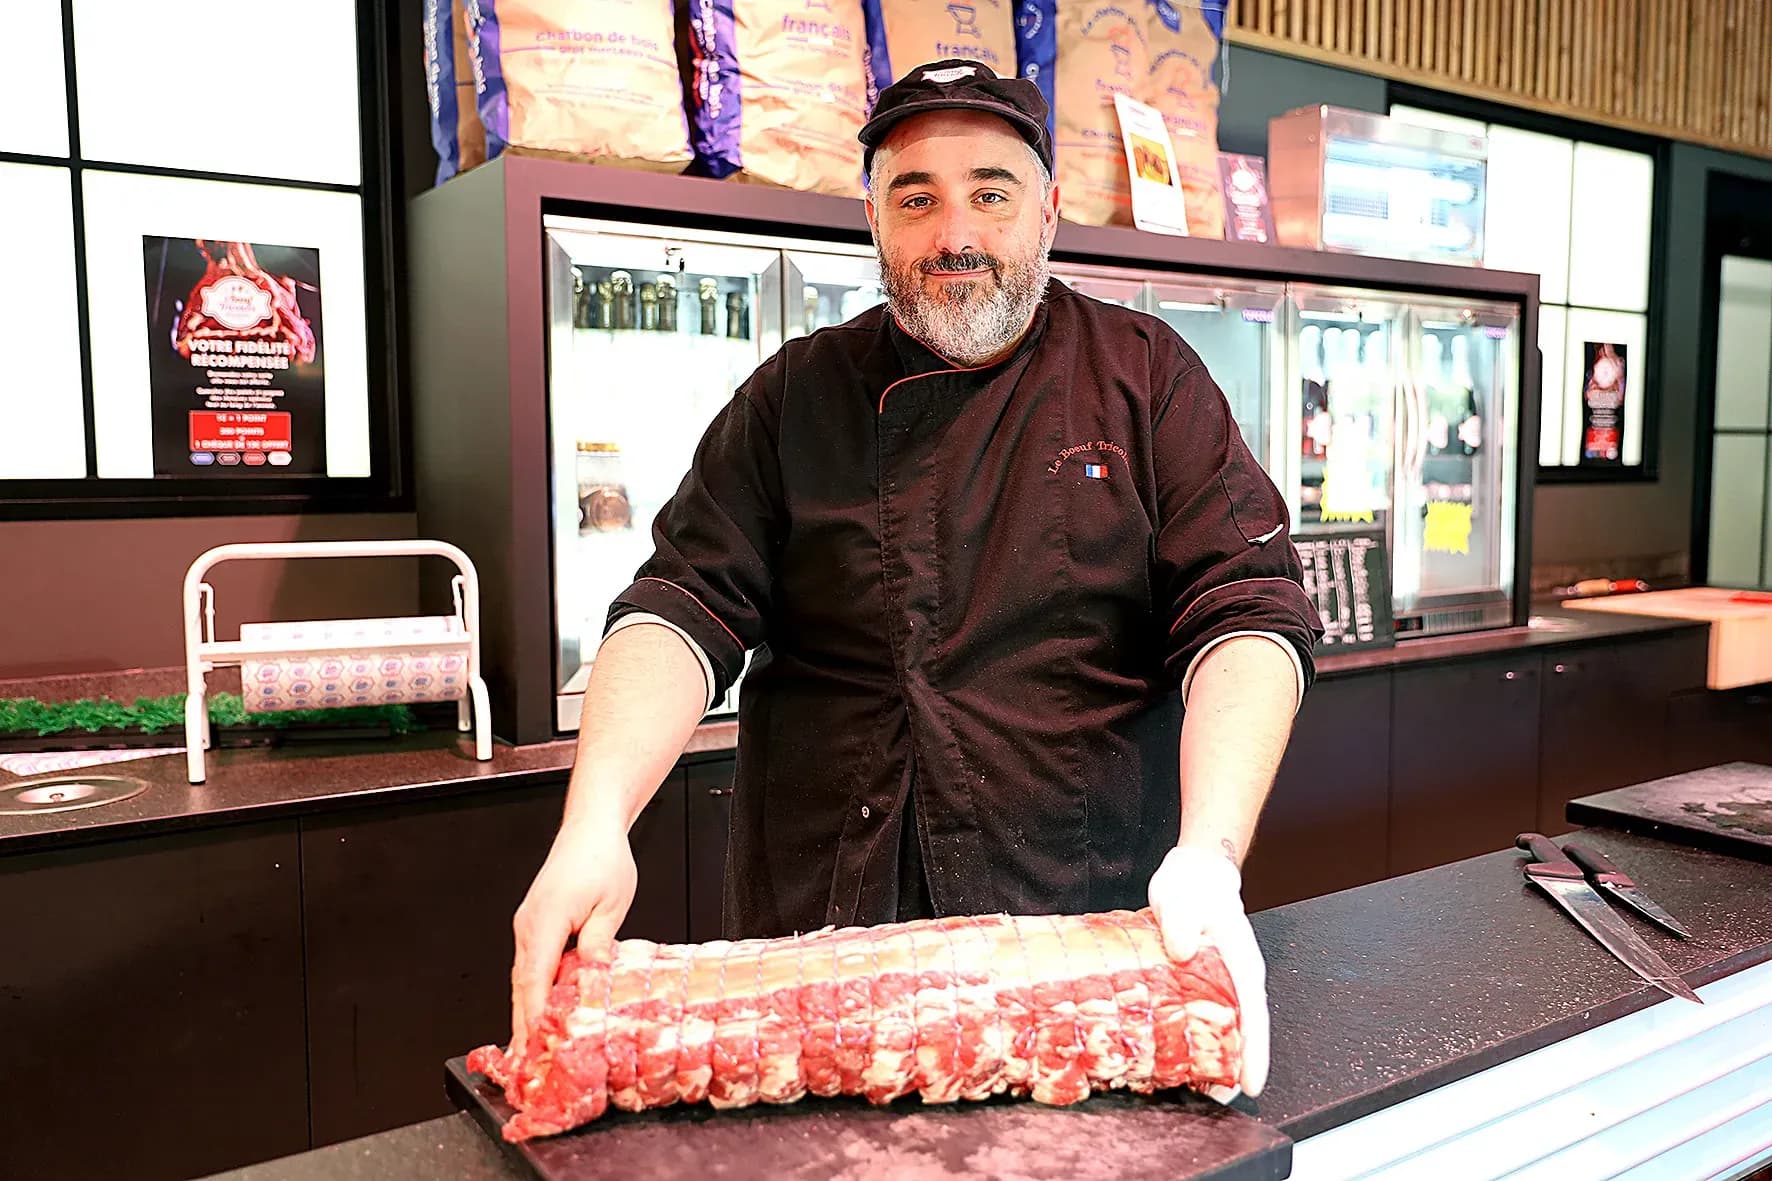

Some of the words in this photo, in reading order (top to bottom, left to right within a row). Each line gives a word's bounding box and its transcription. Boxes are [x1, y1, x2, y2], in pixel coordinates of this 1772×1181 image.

[189, 339, 233, 353] VOTRE
[234, 339, 291, 355] FIDÉLITÉ
[190, 353, 289, 370] RÉCOMPENSÉE
[1047, 459, 1062, 475] Le
[1059, 441, 1093, 460] Boeuf
